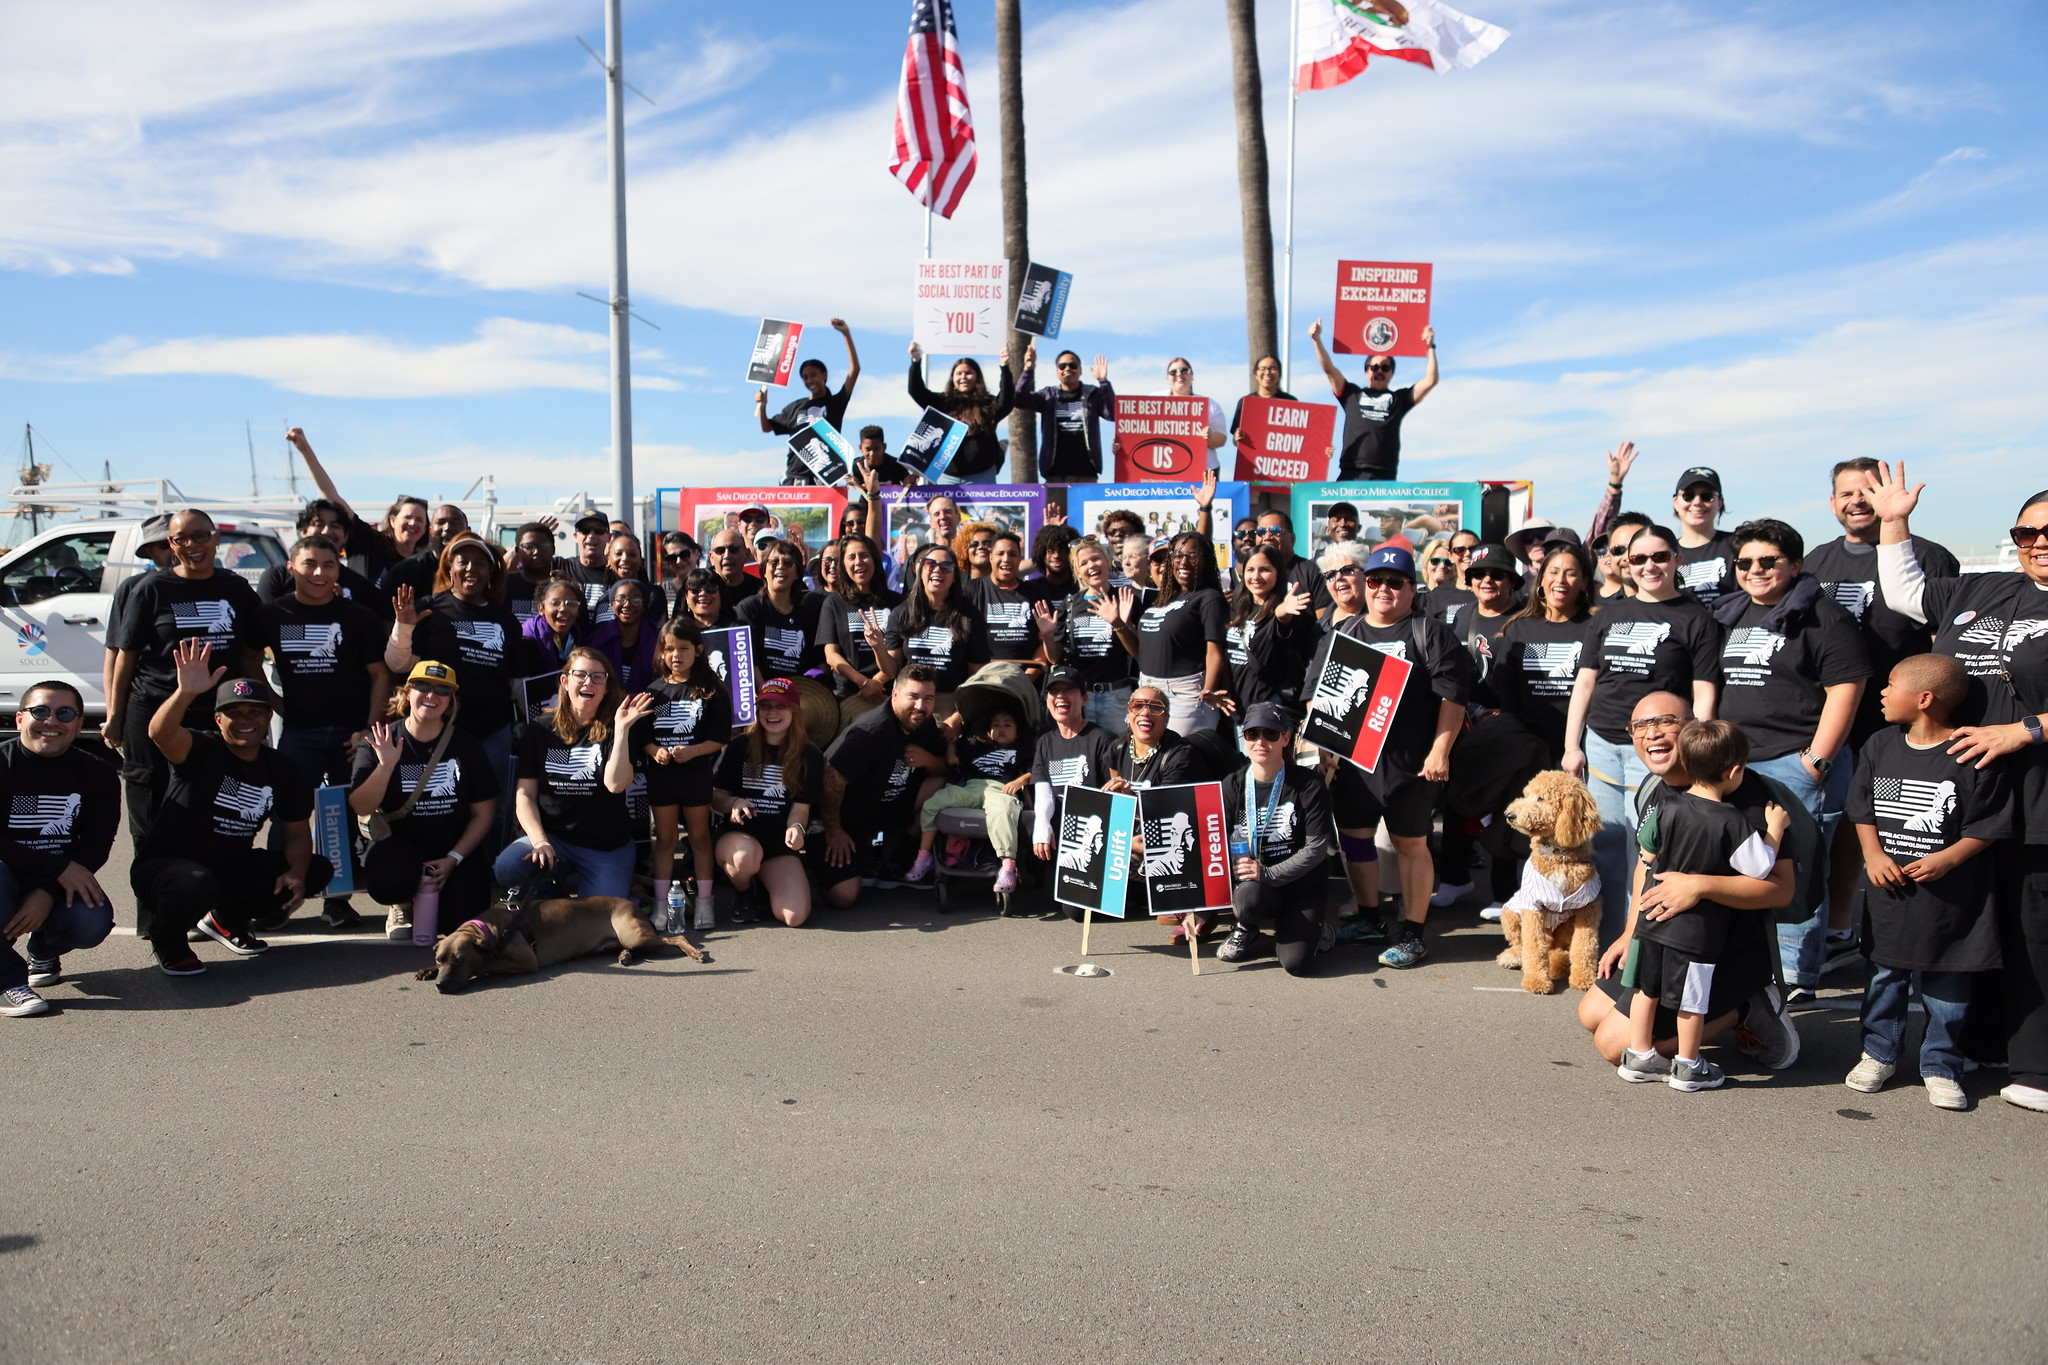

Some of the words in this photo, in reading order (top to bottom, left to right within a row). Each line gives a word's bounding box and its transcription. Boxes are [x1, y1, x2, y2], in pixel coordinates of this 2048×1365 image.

[918, 264, 936, 278] THE
[938, 264, 962, 278] BEST
[964, 264, 989, 279] PART
[991, 265, 1003, 279] OF
[1351, 266, 1418, 284] INSPIRING
[918, 284, 951, 298] SOCIAL
[953, 284, 990, 299] JUSTICE
[992, 285, 1002, 299] IS
[1341, 285, 1426, 304] EXCELLENCE
[1047, 275, 1072, 335] Community
[946, 312, 975, 334] YOU
[780, 335, 798, 373] Change
[1118, 399, 1136, 415] THE
[1138, 400, 1162, 415] BEST
[1164, 401, 1190, 416] PART
[1191, 402, 1204, 416] OF
[1267, 405, 1309, 429] LEARN
[1118, 419, 1151, 434] SOCIAL
[1153, 420, 1190, 436] JUSTICE
[1192, 421, 1203, 436] IS
[933, 435, 960, 470] Respect
[1266, 431, 1304, 454] GROW
[1153, 446, 1173, 469] US
[1253, 456, 1309, 480] SUCCEED
[716, 491, 732, 501] SAN
[732, 491, 758, 501] DIEGO
[758, 491, 776, 500] CITY
[776, 491, 810, 500] COLLEGE
[955, 490, 999, 498] CONTINUING
[1000, 490, 1039, 498] EDUCATION
[1104, 487, 1121, 497] SAN
[1122, 488, 1150, 497] DIEGO
[1150, 487, 1174, 496] MESA
[1320, 487, 1338, 497] SAN
[1340, 487, 1368, 497] DIEGO
[1369, 487, 1411, 496] MIRAMAR
[1412, 487, 1449, 496] COLLEGE
[19, 658, 49, 667] SDCCD
[733, 630, 752, 721] Compassion
[1367, 695, 1393, 733] Rise
[324, 804, 343, 878] Harmony
[1206, 813, 1224, 877] Dream
[1896, 841, 1932, 850] UNFOLDING
[1921, 837, 1945, 845] DREAM
[1108, 829, 1128, 881] Uplift
